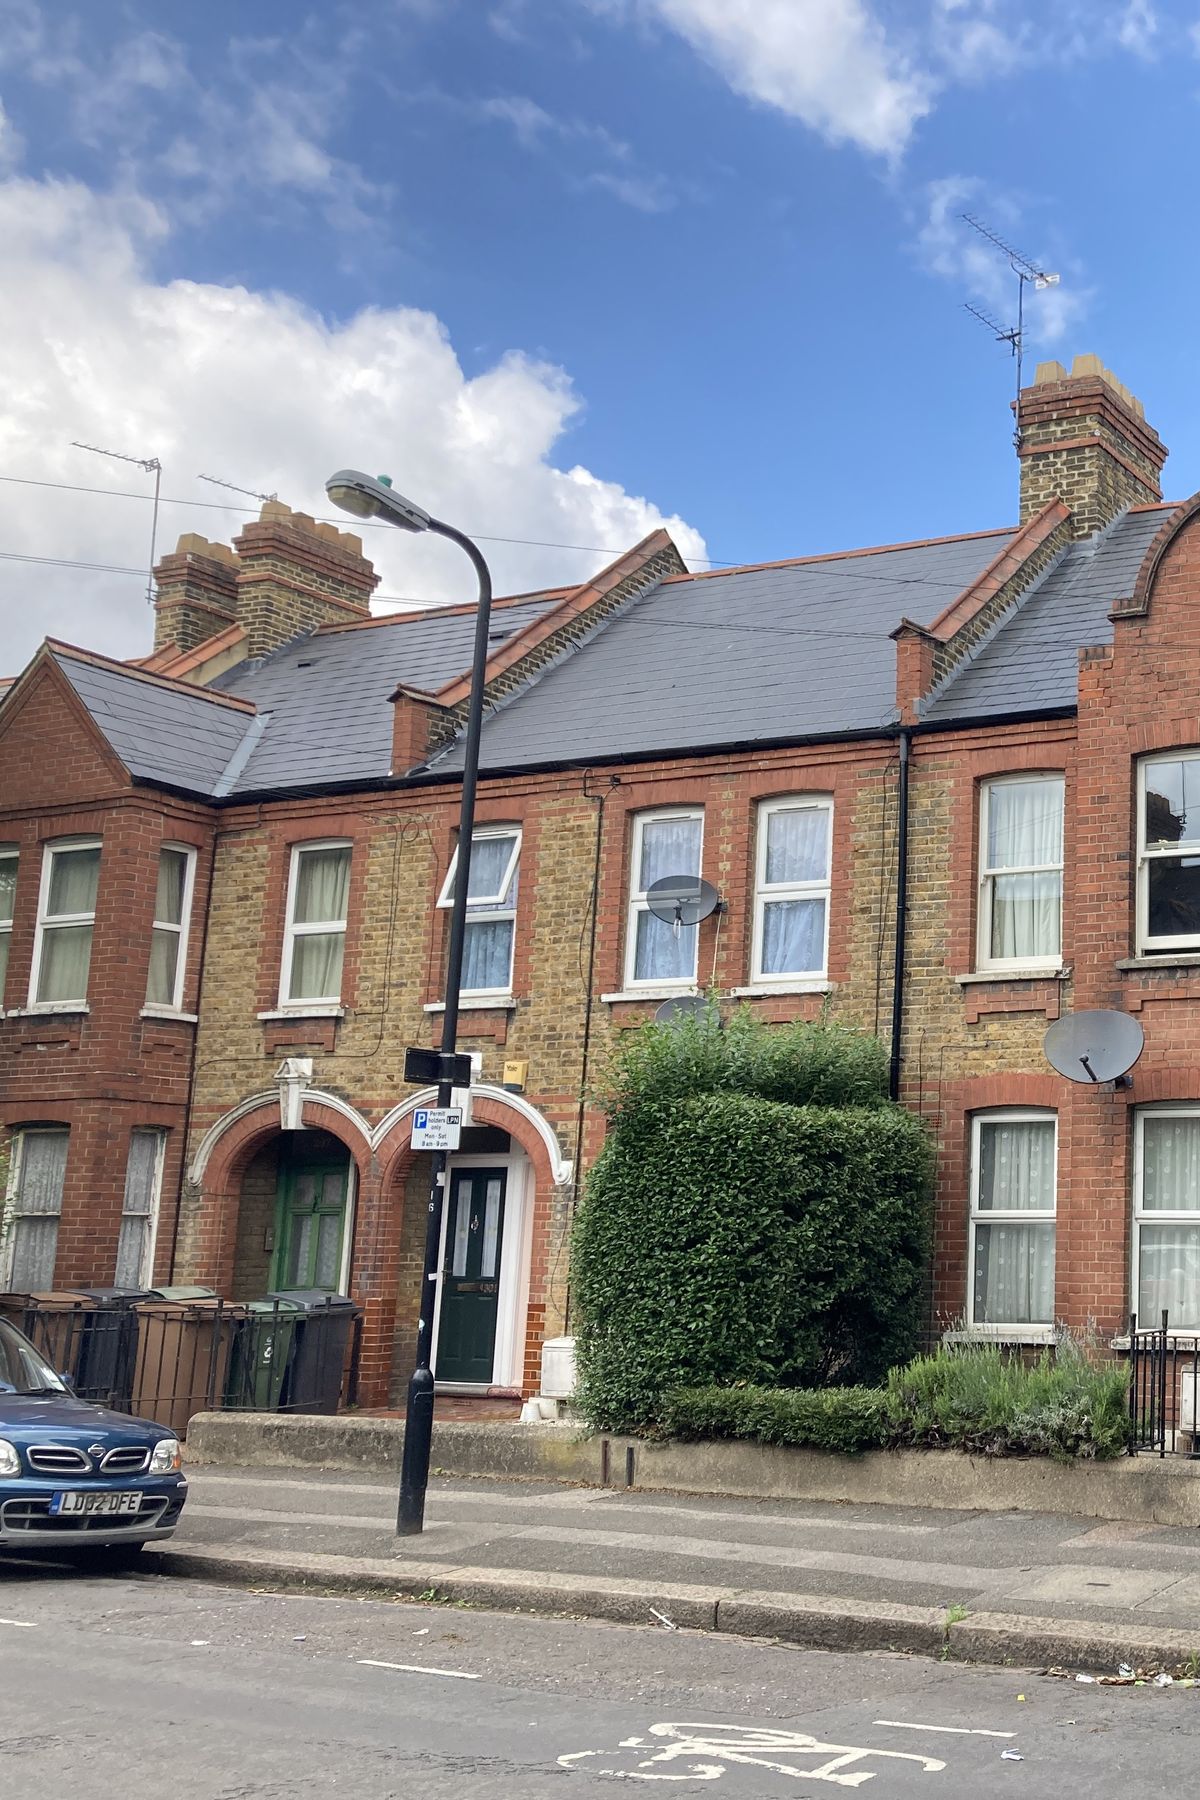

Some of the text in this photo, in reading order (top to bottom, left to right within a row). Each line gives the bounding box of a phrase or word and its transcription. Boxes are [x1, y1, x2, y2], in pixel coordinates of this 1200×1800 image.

[417, 1113, 426, 1128] P
[447, 1116, 459, 1124] LPN
[61, 1493, 140, 1511] LD02 DFE
